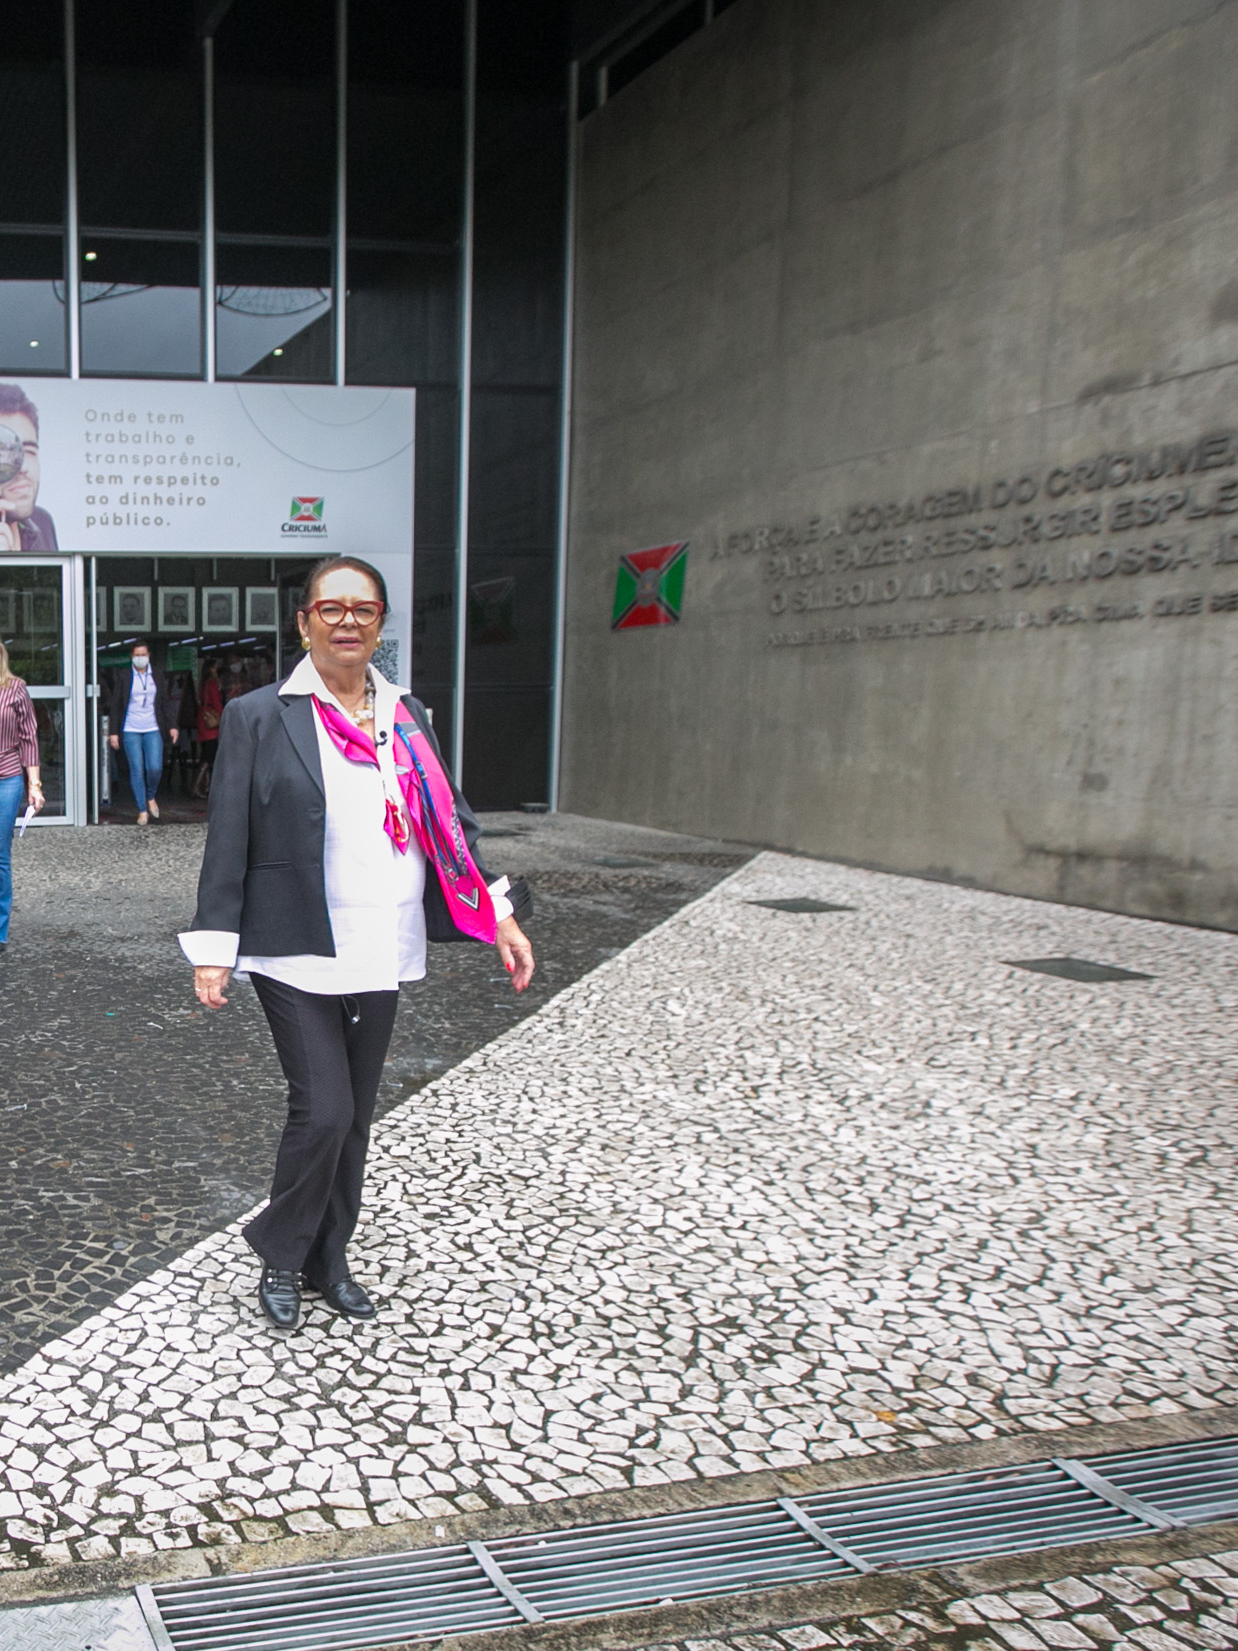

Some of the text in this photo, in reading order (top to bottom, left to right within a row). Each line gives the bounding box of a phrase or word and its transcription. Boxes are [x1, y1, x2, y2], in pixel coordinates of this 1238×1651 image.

[85, 409, 185, 424] Onde tem
[84, 430, 195, 445] trabalho e
[85, 451, 242, 468] transparência,
[86, 472, 220, 488] tem respeito
[86, 491, 206, 507] ao dinheiro
[846, 482, 983, 535] CORAGEM
[990, 475, 1039, 510] DO
[86, 512, 171, 528] público.
[828, 534, 911, 577] FAZER
[920, 504, 1101, 560] RESSURGIR
[1011, 559, 1058, 591] DA
[1065, 539, 1200, 584] NOSSA
